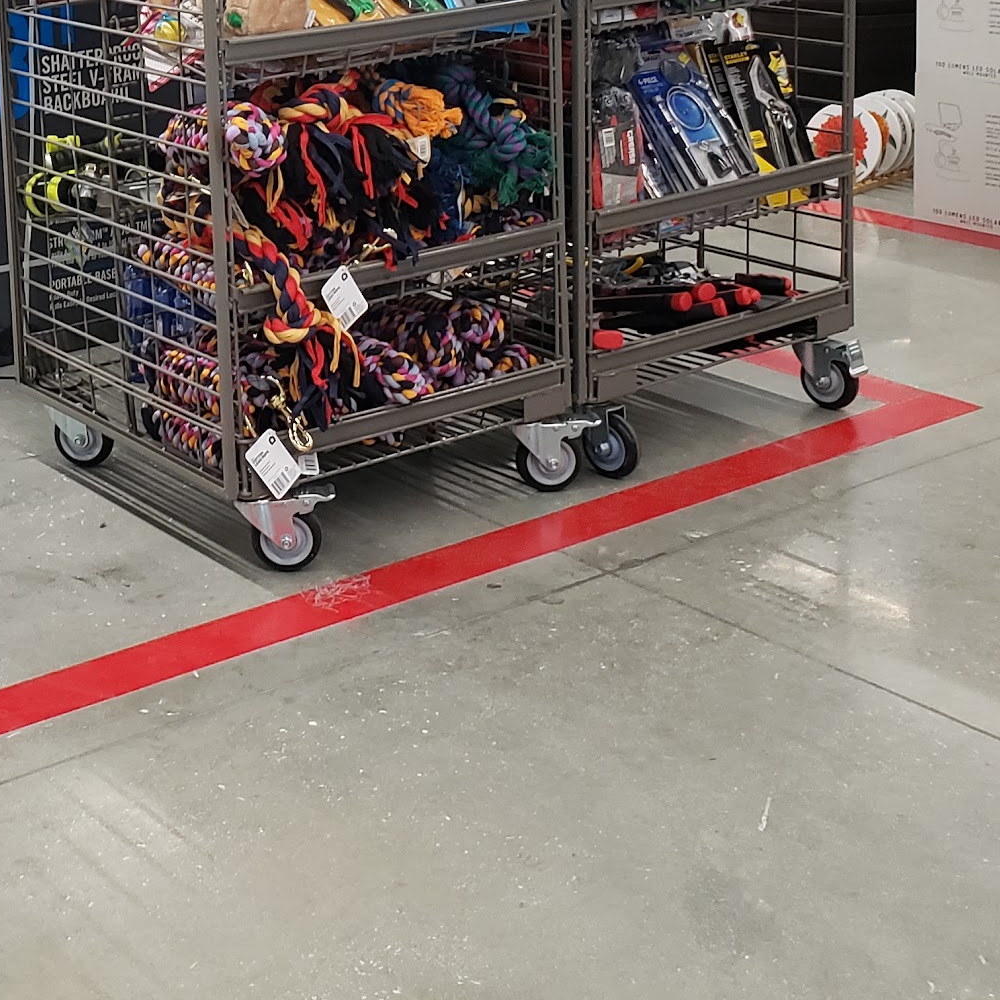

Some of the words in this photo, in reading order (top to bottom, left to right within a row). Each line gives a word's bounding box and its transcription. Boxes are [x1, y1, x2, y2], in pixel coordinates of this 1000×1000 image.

[42, 42, 141, 74] SHATTERROO
[724, 52, 748, 60] STANLEY
[89, 62, 141, 87] V-RAM
